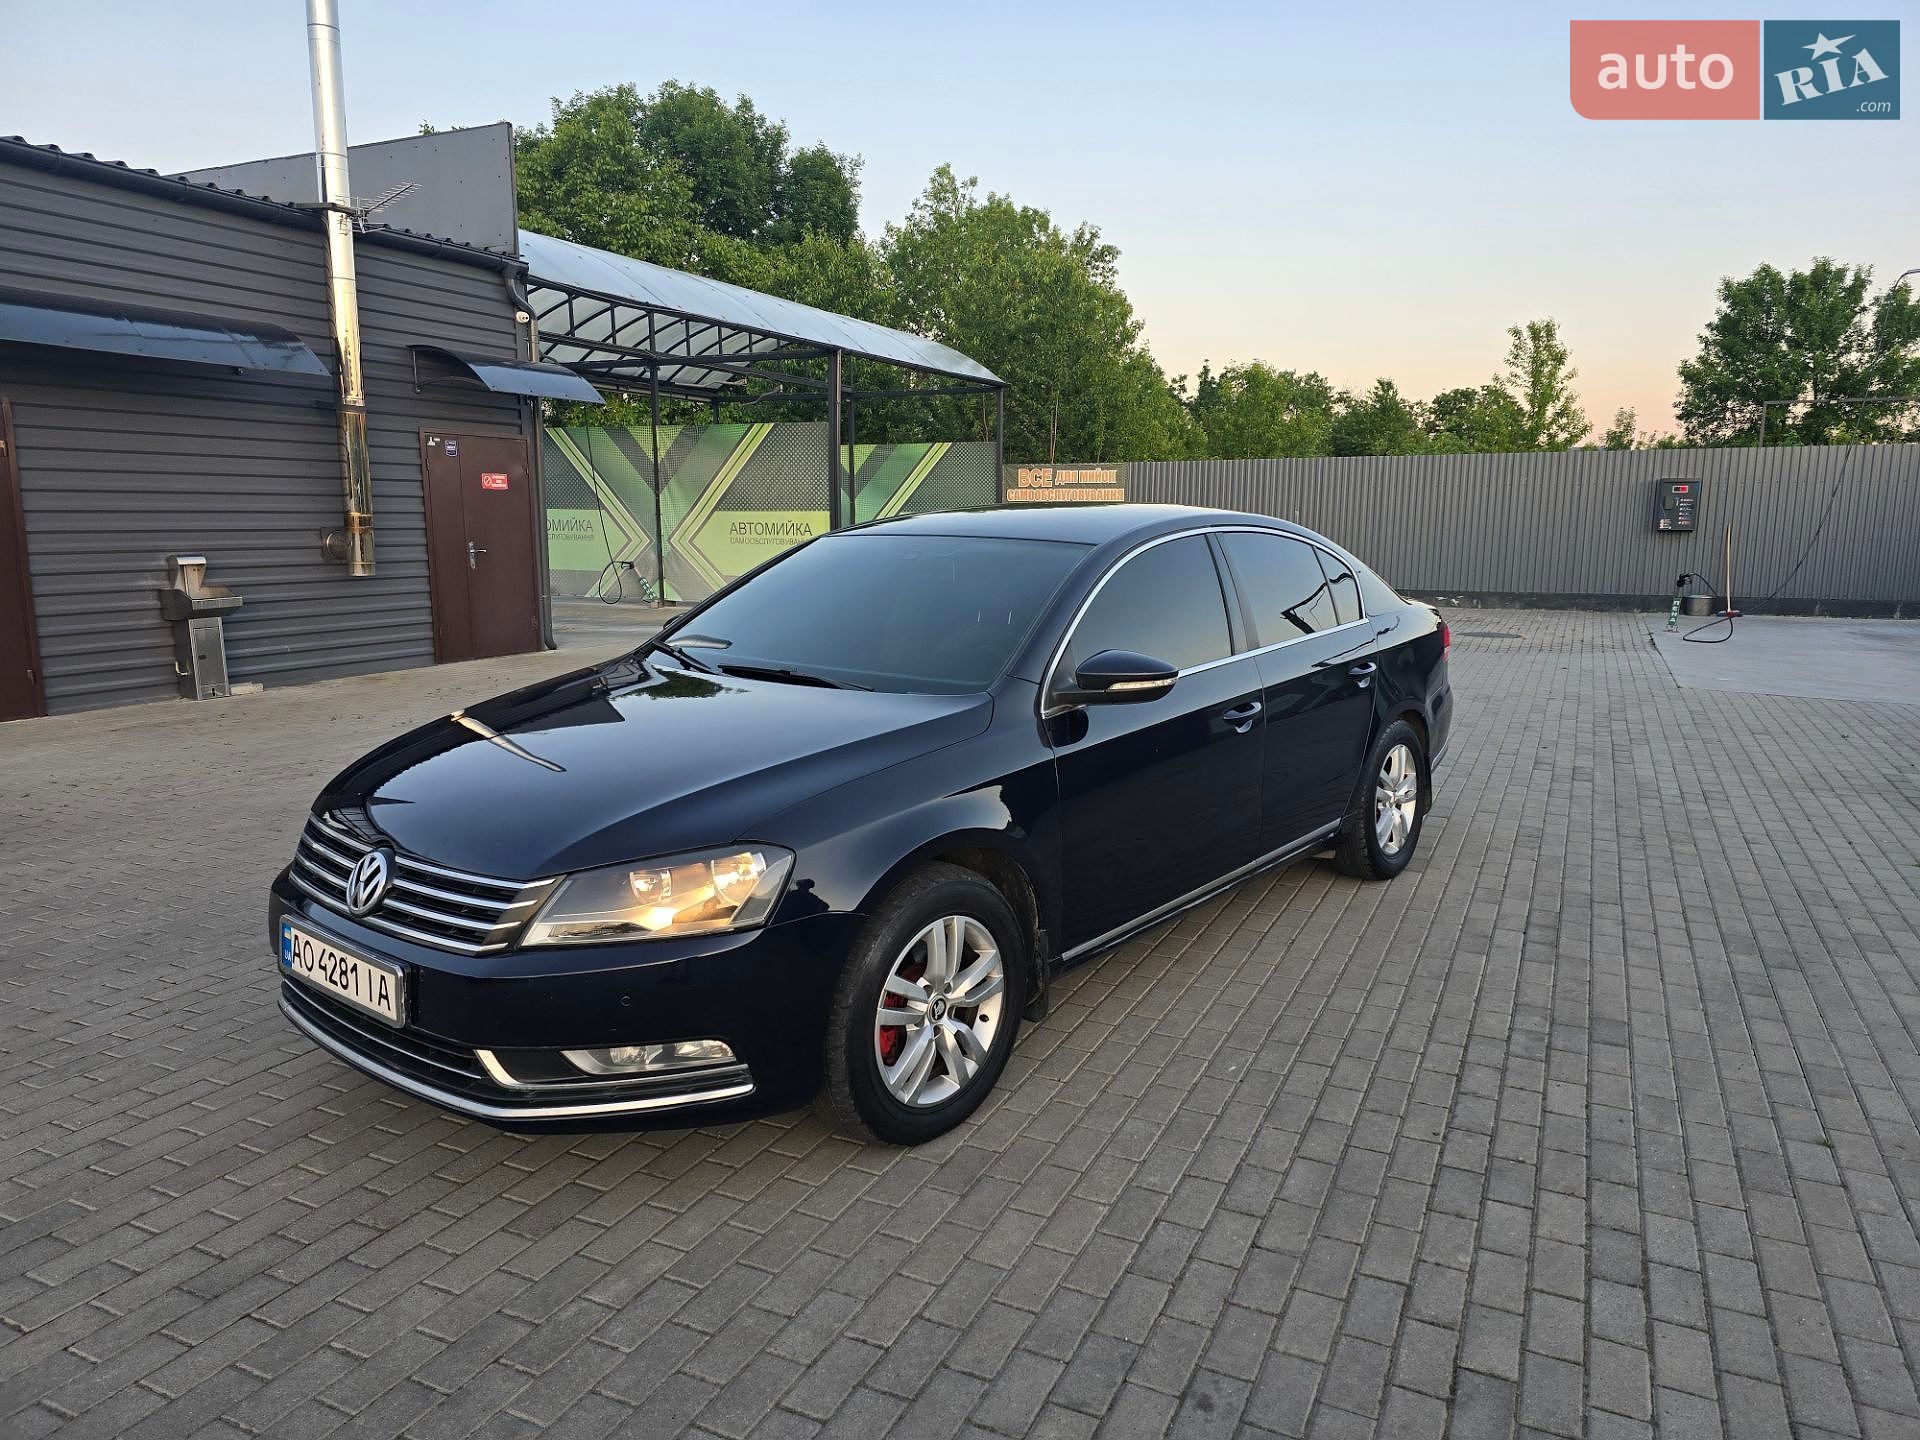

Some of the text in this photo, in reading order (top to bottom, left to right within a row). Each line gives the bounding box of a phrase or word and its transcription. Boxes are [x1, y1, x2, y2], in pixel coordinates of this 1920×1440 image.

[1018, 467, 1053, 488] ВСЕ
[729, 520, 813, 536] АВТОМИЙКА
[318, 948, 359, 997] 4281
